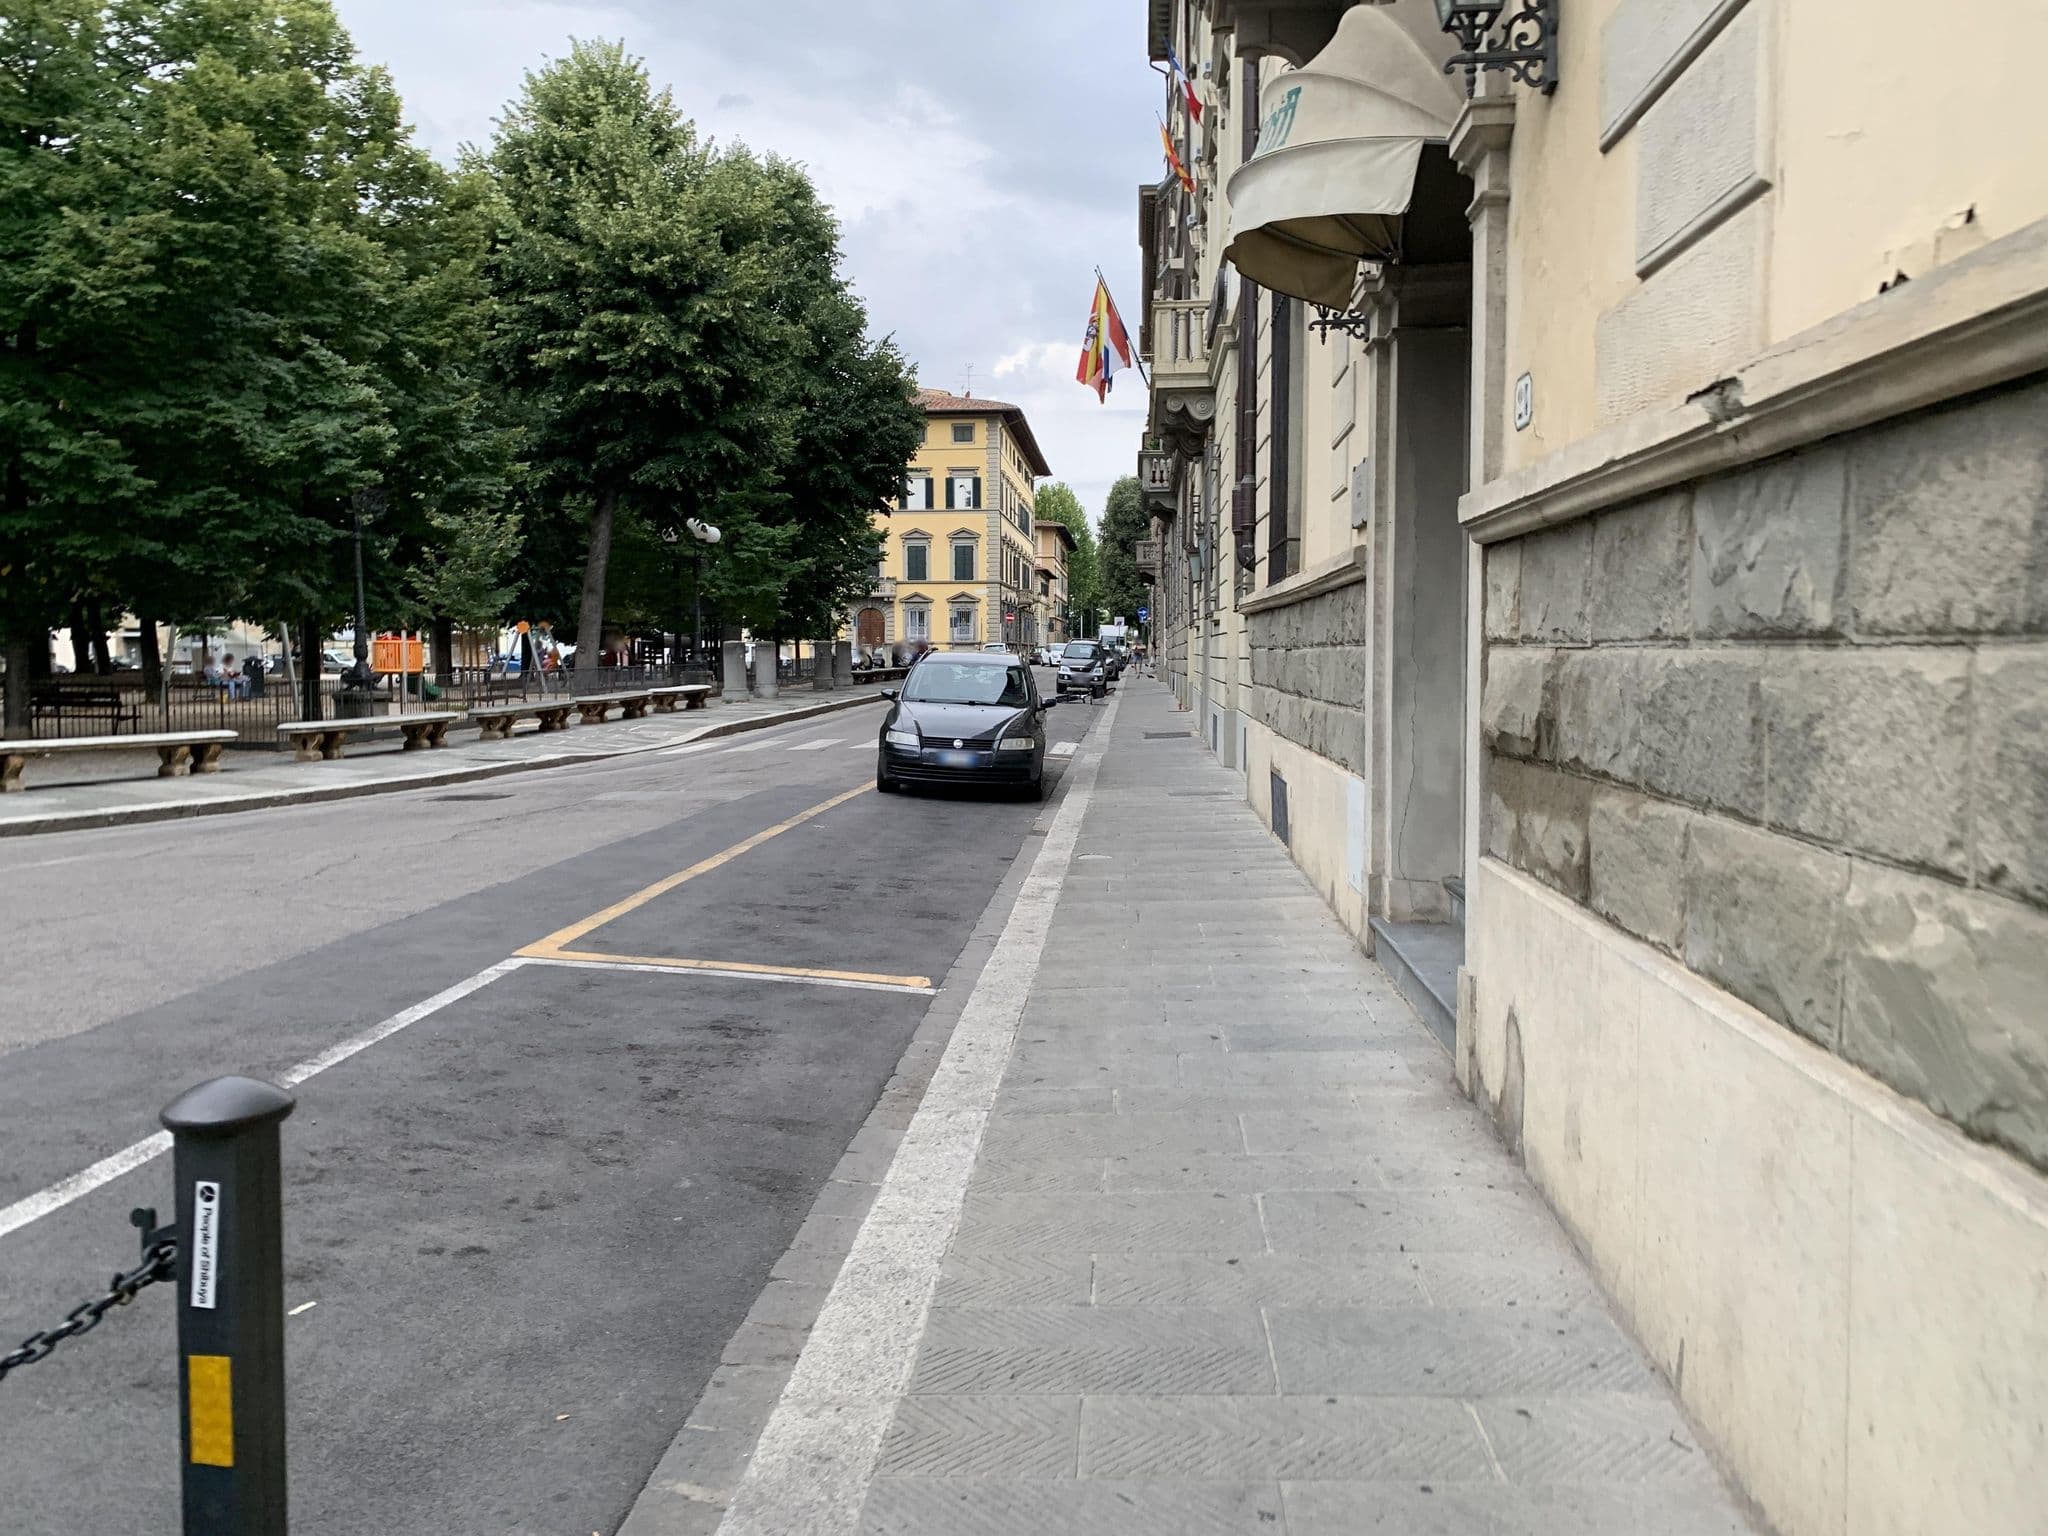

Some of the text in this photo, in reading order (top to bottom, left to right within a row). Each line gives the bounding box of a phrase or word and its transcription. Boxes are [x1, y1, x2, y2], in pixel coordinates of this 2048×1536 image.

[198, 1207, 213, 1304] People of Shibuya
